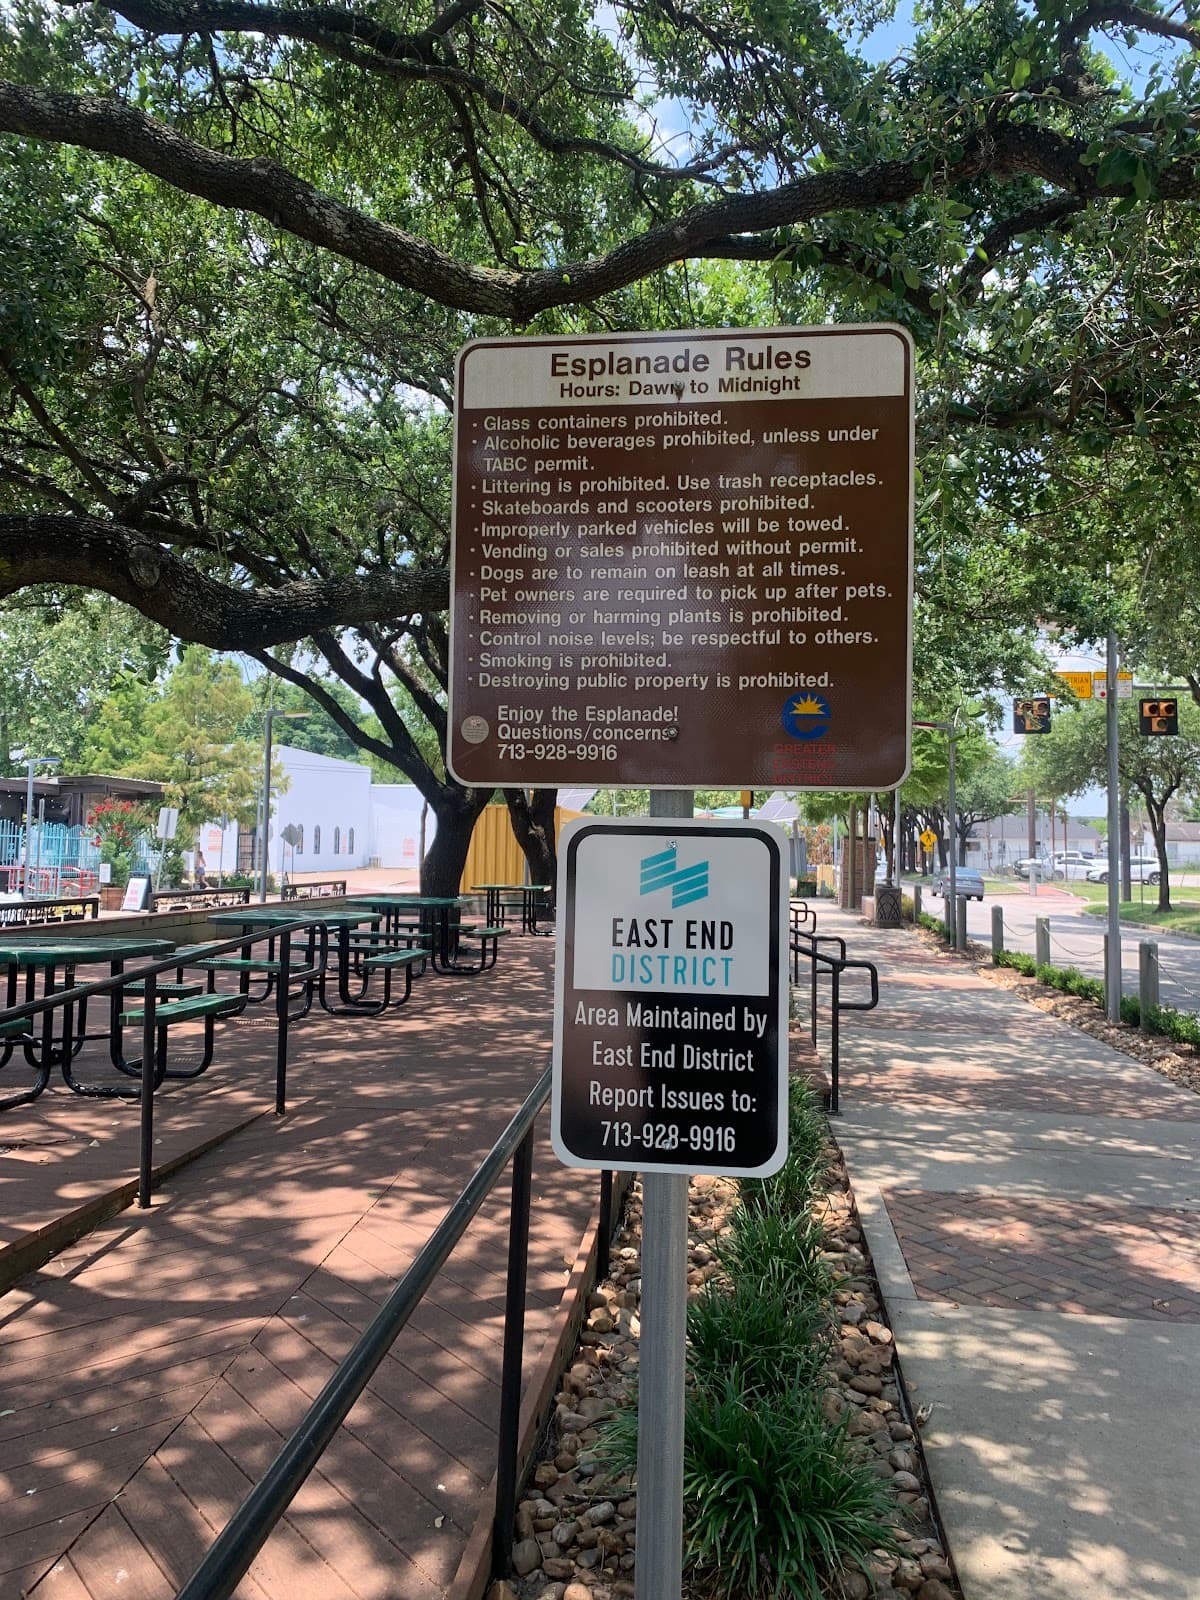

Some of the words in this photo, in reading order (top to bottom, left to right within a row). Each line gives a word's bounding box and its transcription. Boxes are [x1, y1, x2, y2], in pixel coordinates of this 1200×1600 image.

[550, 348, 710, 381] Esplanade
[726, 346, 810, 370] Rules
[561, 383, 619, 398] Hours:
[689, 379, 709, 394] to
[719, 376, 800, 394] Midnight
[483, 415, 530, 431] Glass
[538, 414, 627, 429] containers
[635, 410, 727, 429] prohibited.
[484, 435, 559, 450] Alcoholic
[568, 435, 655, 450] beverages
[664, 430, 754, 449] prohibited,
[763, 428, 819, 443] unless
[829, 426, 878, 441] under
[482, 456, 527, 472] TABC
[535, 456, 594, 474] permit.
[483, 479, 550, 496] Littering
[558, 477, 572, 493] is
[580, 476, 669, 495] prohibited.
[678, 475, 710, 490] Use
[718, 473, 762, 489] trash
[771, 471, 882, 489] receptacles.
[483, 500, 589, 515] Skateboards
[596, 498, 628, 514] and
[636, 498, 712, 513] scooters
[721, 494, 814, 514] prohibited.
[482, 522, 570, 539] Improperly
[578, 520, 636, 538] parked
[644, 519, 714, 535] vehicles
[721, 517, 750, 533] will
[757, 517, 780, 533] be
[788, 516, 849, 531] towed.
[482, 544, 547, 561] Vending
[554, 546, 573, 558] or
[579, 542, 625, 558] sales
[632, 541, 718, 559] prohibited
[727, 540, 791, 555] without
[800, 539, 862, 556] permit.
[481, 566, 523, 583] Dogs
[531, 568, 559, 580] are
[566, 565, 583, 580] to
[590, 564, 647, 580] remain
[654, 567, 676, 579] on
[684, 563, 729, 578] leash
[736, 562, 755, 578] at
[762, 561, 784, 577] all
[789, 561, 846, 577] times.
[480, 587, 508, 602] Pet
[514, 589, 576, 602] owners
[582, 589, 610, 602] are
[618, 586, 687, 603] required
[695, 585, 713, 601] to
[721, 585, 757, 602] pick
[765, 587, 787, 603] up
[794, 583, 839, 599] after
[846, 583, 891, 600] pets.
[481, 610, 561, 627] Removing
[568, 612, 587, 625] or
[594, 610, 660, 626] harming
[669, 609, 721, 626] plants
[729, 607, 744, 623] is
[752, 607, 848, 625] prohibited.
[479, 630, 541, 646] Control
[548, 631, 594, 646] noise
[602, 631, 654, 648] levels;
[662, 630, 684, 646] be
[692, 630, 780, 648] respectful
[788, 629, 807, 645] to
[814, 628, 879, 644] others.
[480, 653, 551, 670] Smoking
[559, 652, 574, 668] is
[582, 653, 671, 670] prohibited.
[479, 673, 569, 690] Destroying
[577, 673, 627, 690] public
[635, 674, 708, 690] property
[716, 672, 731, 688] is
[739, 672, 833, 690] prohibited.
[498, 705, 543, 723] Enjoy
[552, 706, 577, 721] the
[586, 706, 677, 724] Esplanade!
[498, 744, 617, 760] 713-928-9916
[611, 917, 673, 949] EAST
[686, 920, 733, 950] END
[611, 954, 734, 987] DISTRICT
[575, 1001, 618, 1026] Area
[627, 1002, 735, 1030] Maintained
[744, 1007, 767, 1037] by
[593, 1041, 633, 1066] East
[641, 1043, 675, 1068] End
[684, 1045, 754, 1071] District
[590, 1081, 653, 1112] Report
[662, 1084, 724, 1110] Issues
[732, 1090, 756, 1112] to:
[601, 1121, 735, 1152] 713-928-9916
